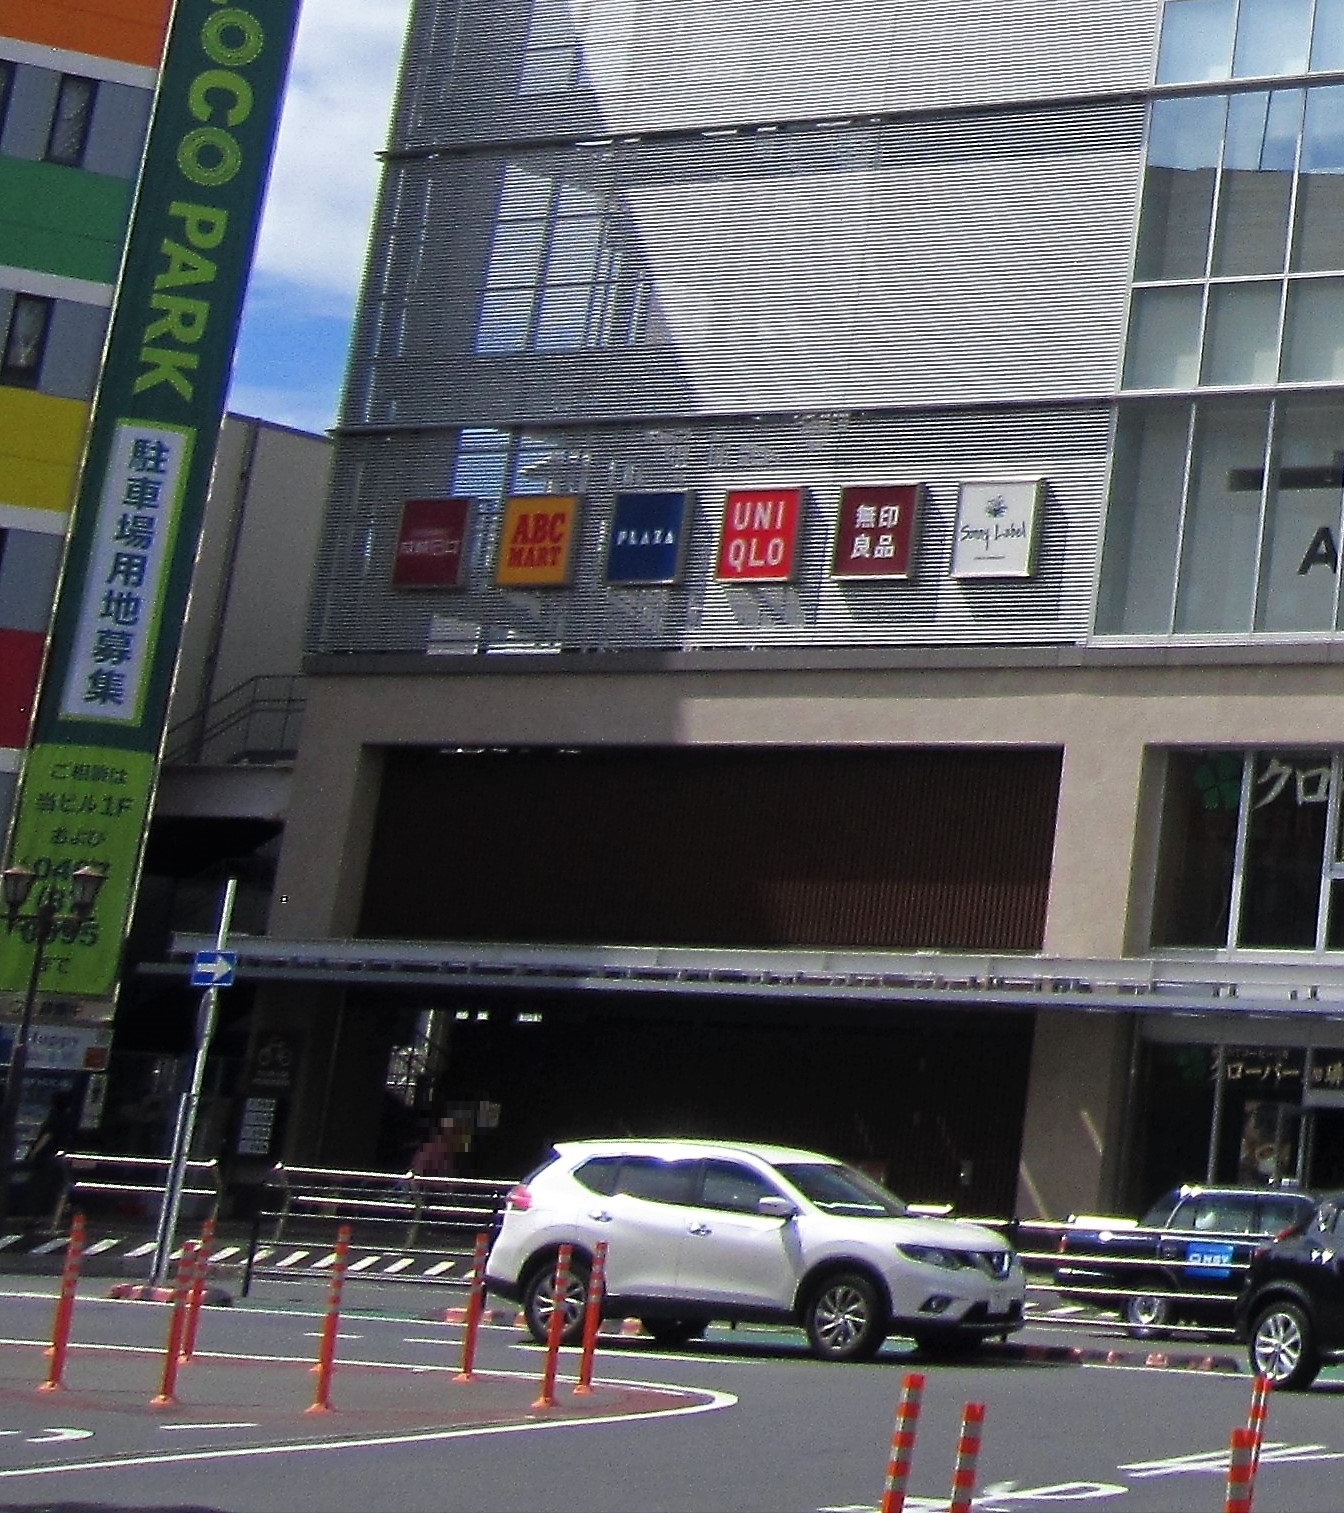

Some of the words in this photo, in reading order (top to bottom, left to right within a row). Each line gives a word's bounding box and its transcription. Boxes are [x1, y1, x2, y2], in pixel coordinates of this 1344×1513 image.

[132, 200, 230, 402] PARK
[511, 512, 567, 545] ABC
[733, 500, 786, 531] UNI
[855, 503, 901, 529] 無印
[616, 529, 675, 546] PLAZA
[850, 533, 896, 559] 良品
[506, 546, 562, 568] MART
[727, 537, 785, 573] QLO
[82, 438, 170, 706] 駐車場用地募集
